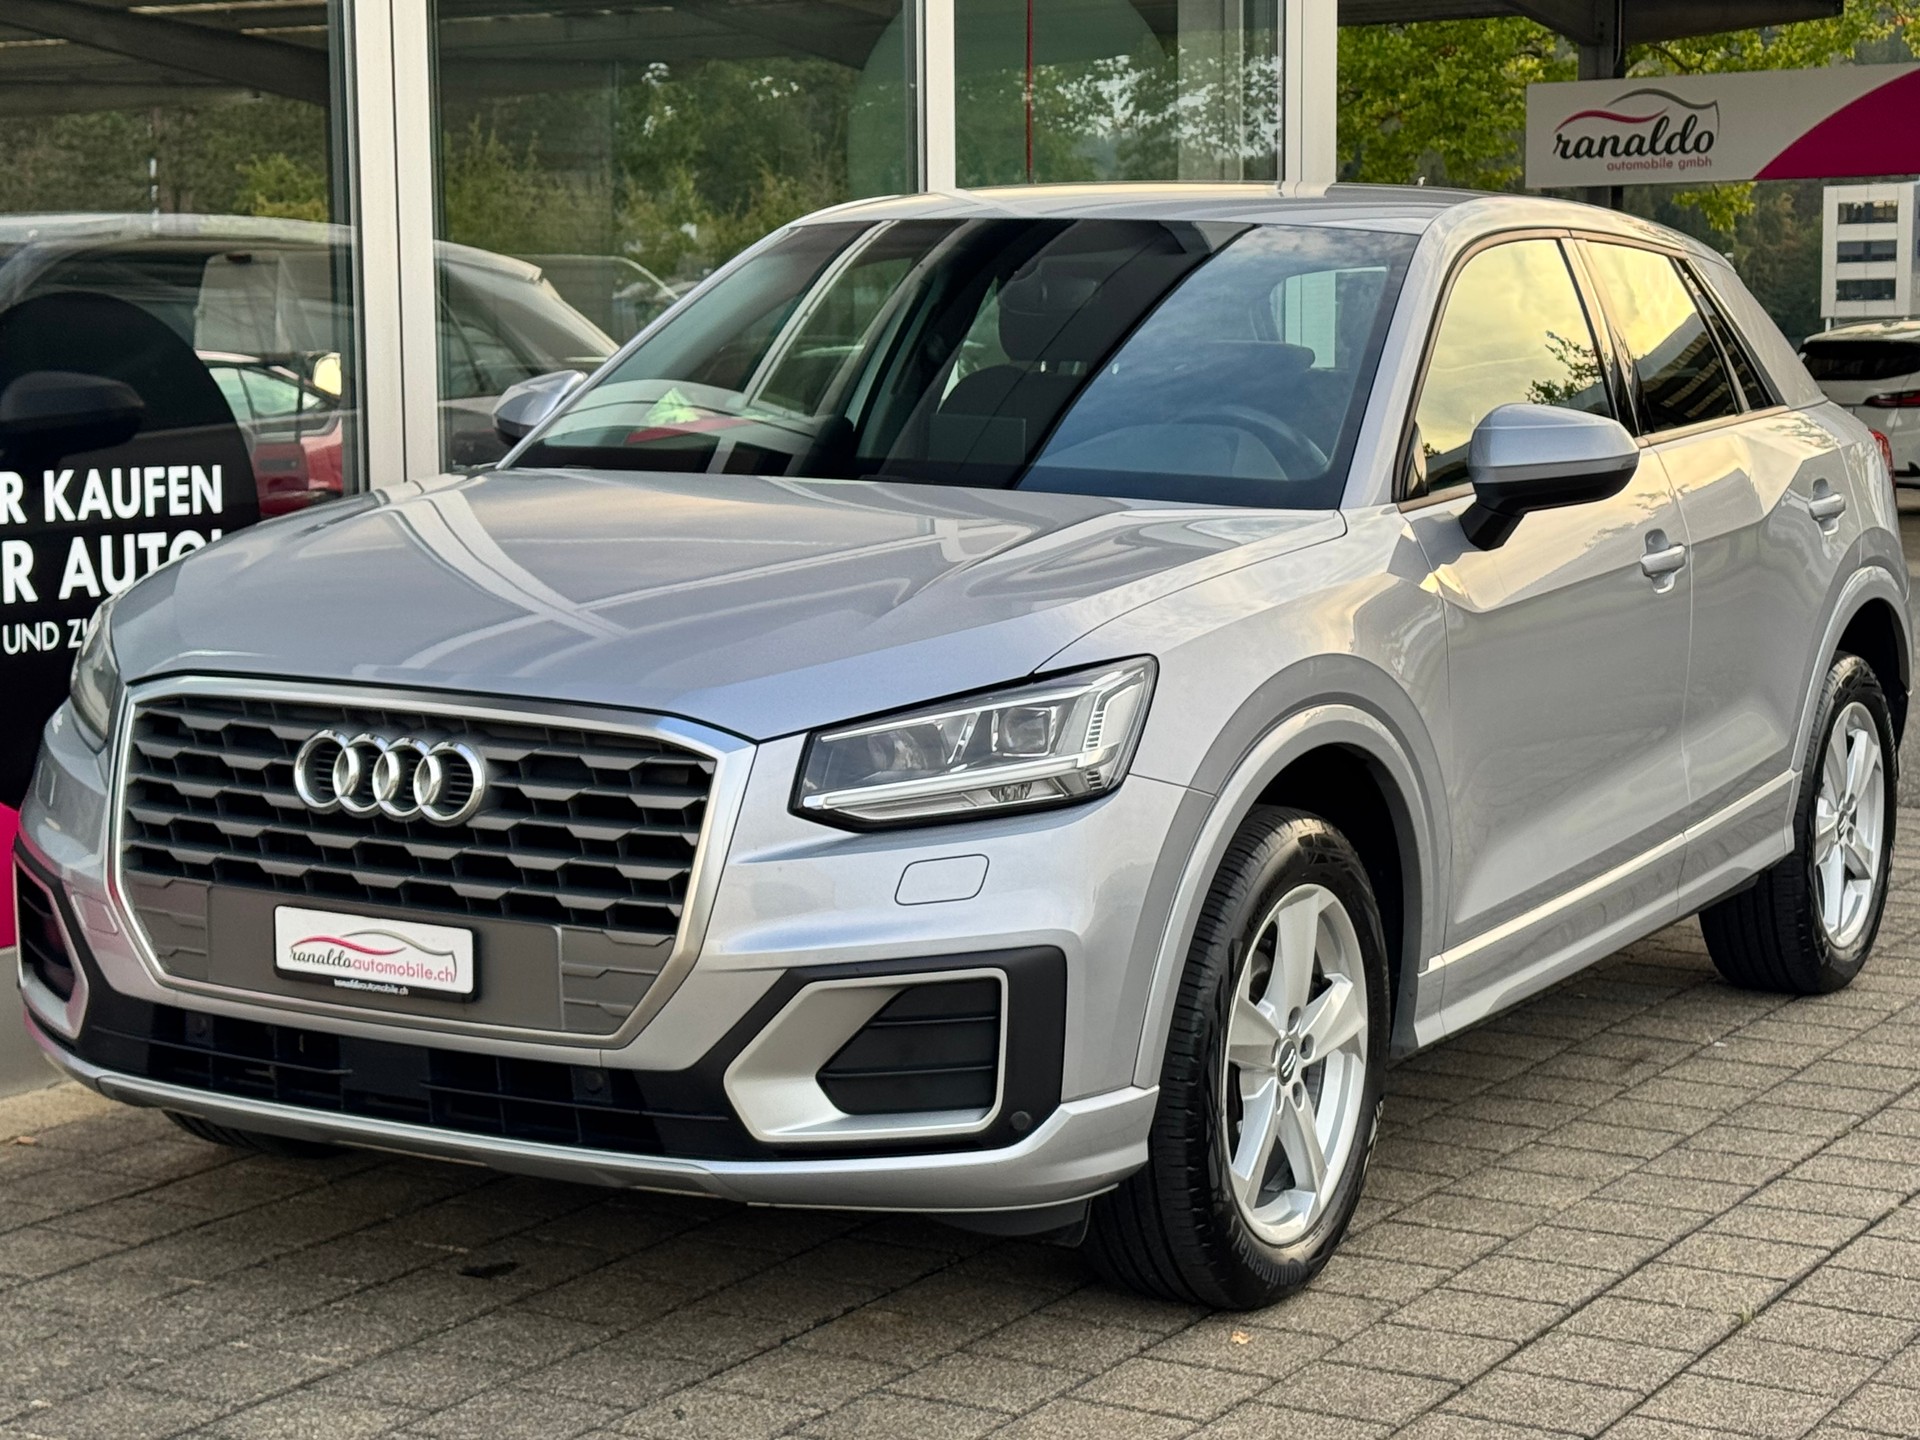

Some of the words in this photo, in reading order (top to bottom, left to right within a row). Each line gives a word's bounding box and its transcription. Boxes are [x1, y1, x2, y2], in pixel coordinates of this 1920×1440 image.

[1552, 114, 1715, 160] ranaldo
[1606, 158, 1674, 172] automobile
[1677, 156, 1713, 171] gmbh
[43, 464, 224, 523] KAUFEN
[2, 539, 39, 604] R
[58, 528, 223, 600] AUT
[2, 620, 61, 655] UND
[66, 617, 89, 649] Z
[289, 947, 455, 983] ranaldoautomobile.ch
